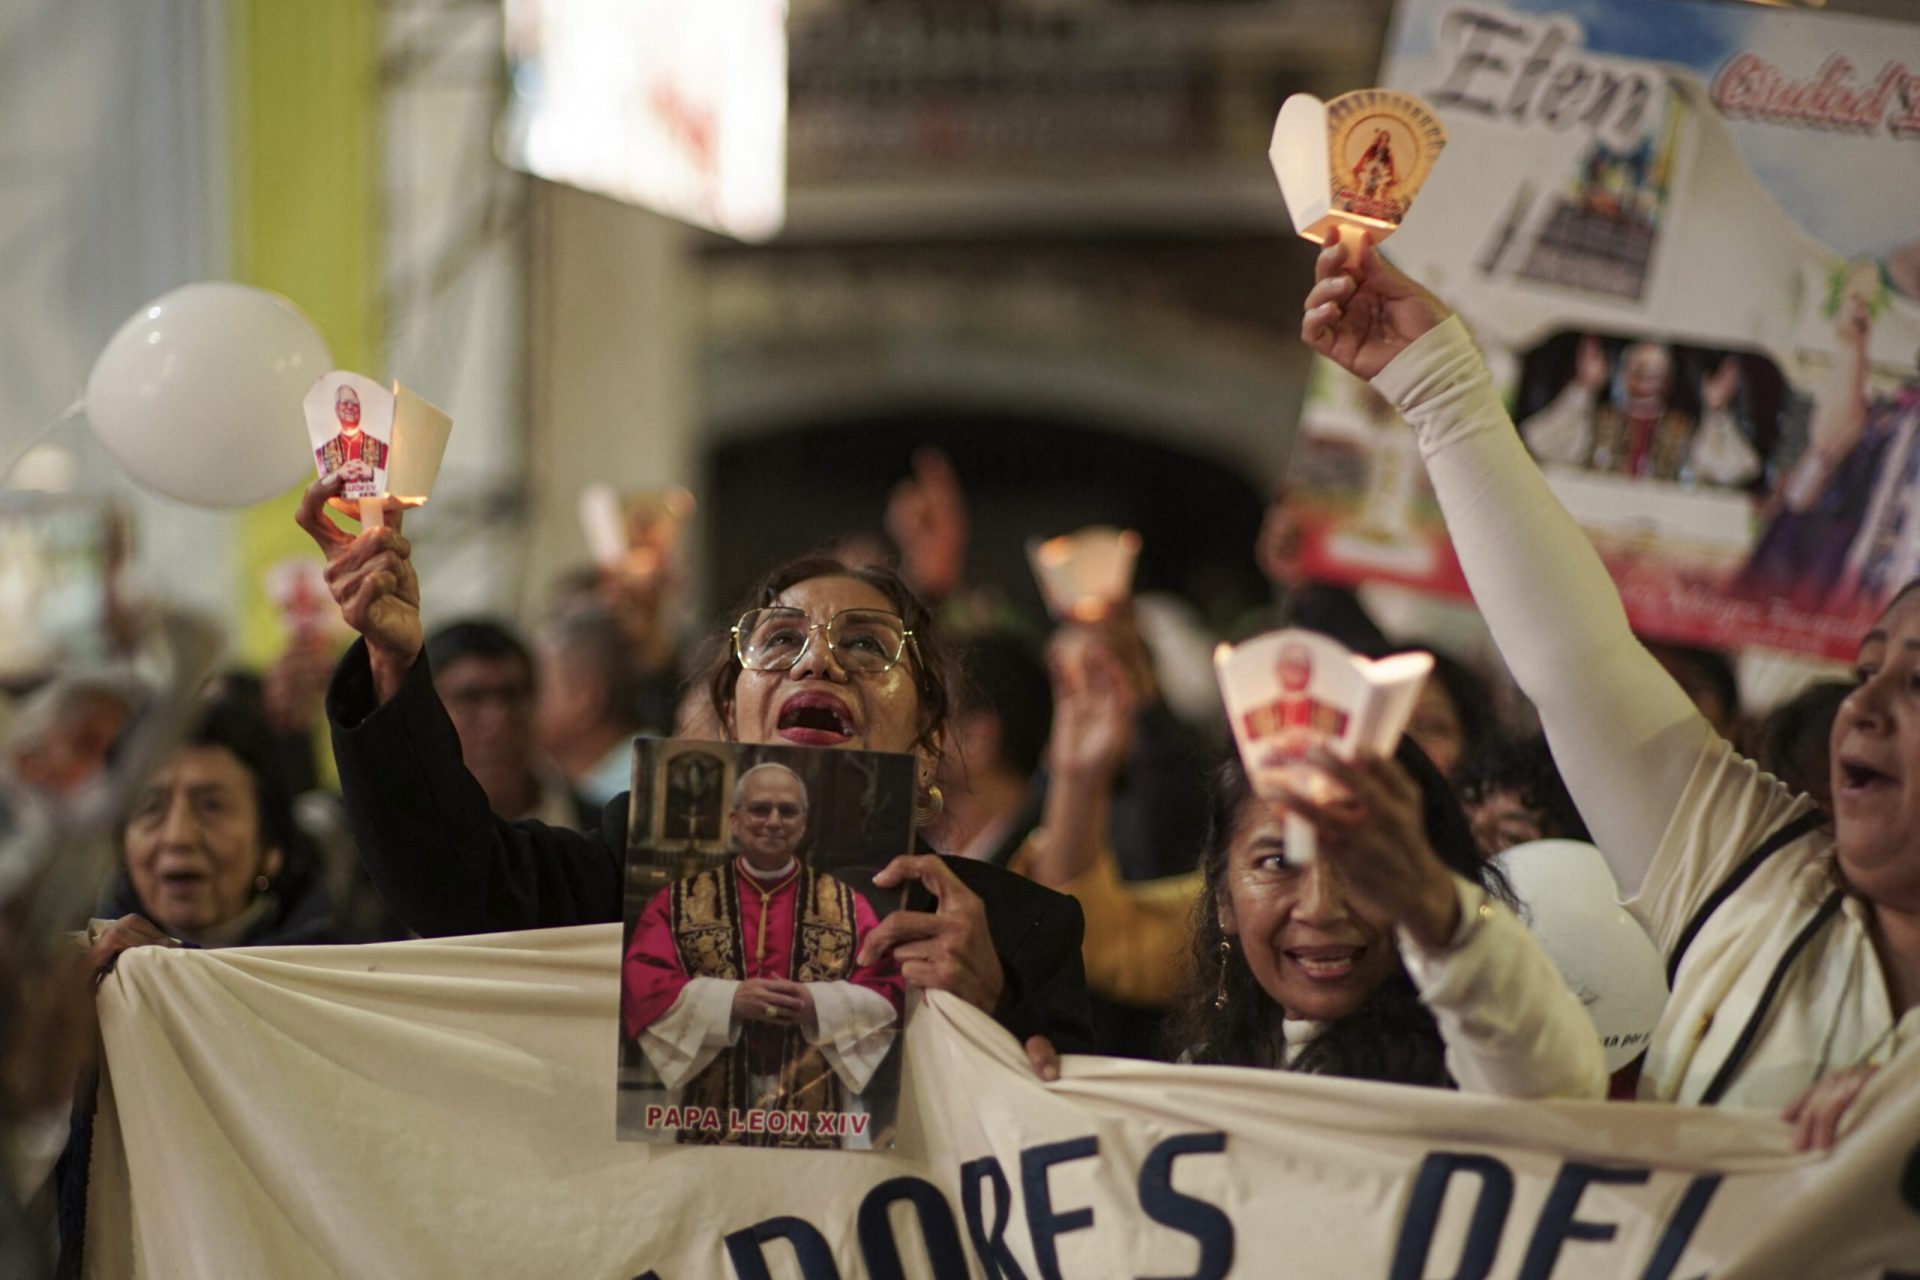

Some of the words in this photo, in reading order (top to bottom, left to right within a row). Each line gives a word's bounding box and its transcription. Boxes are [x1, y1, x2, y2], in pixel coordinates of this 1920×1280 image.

[1710, 50, 1906, 136] Ciudad
[645, 1105, 720, 1131] PAPA
[729, 1108, 809, 1134] LEON
[816, 1112, 870, 1136] XIV
